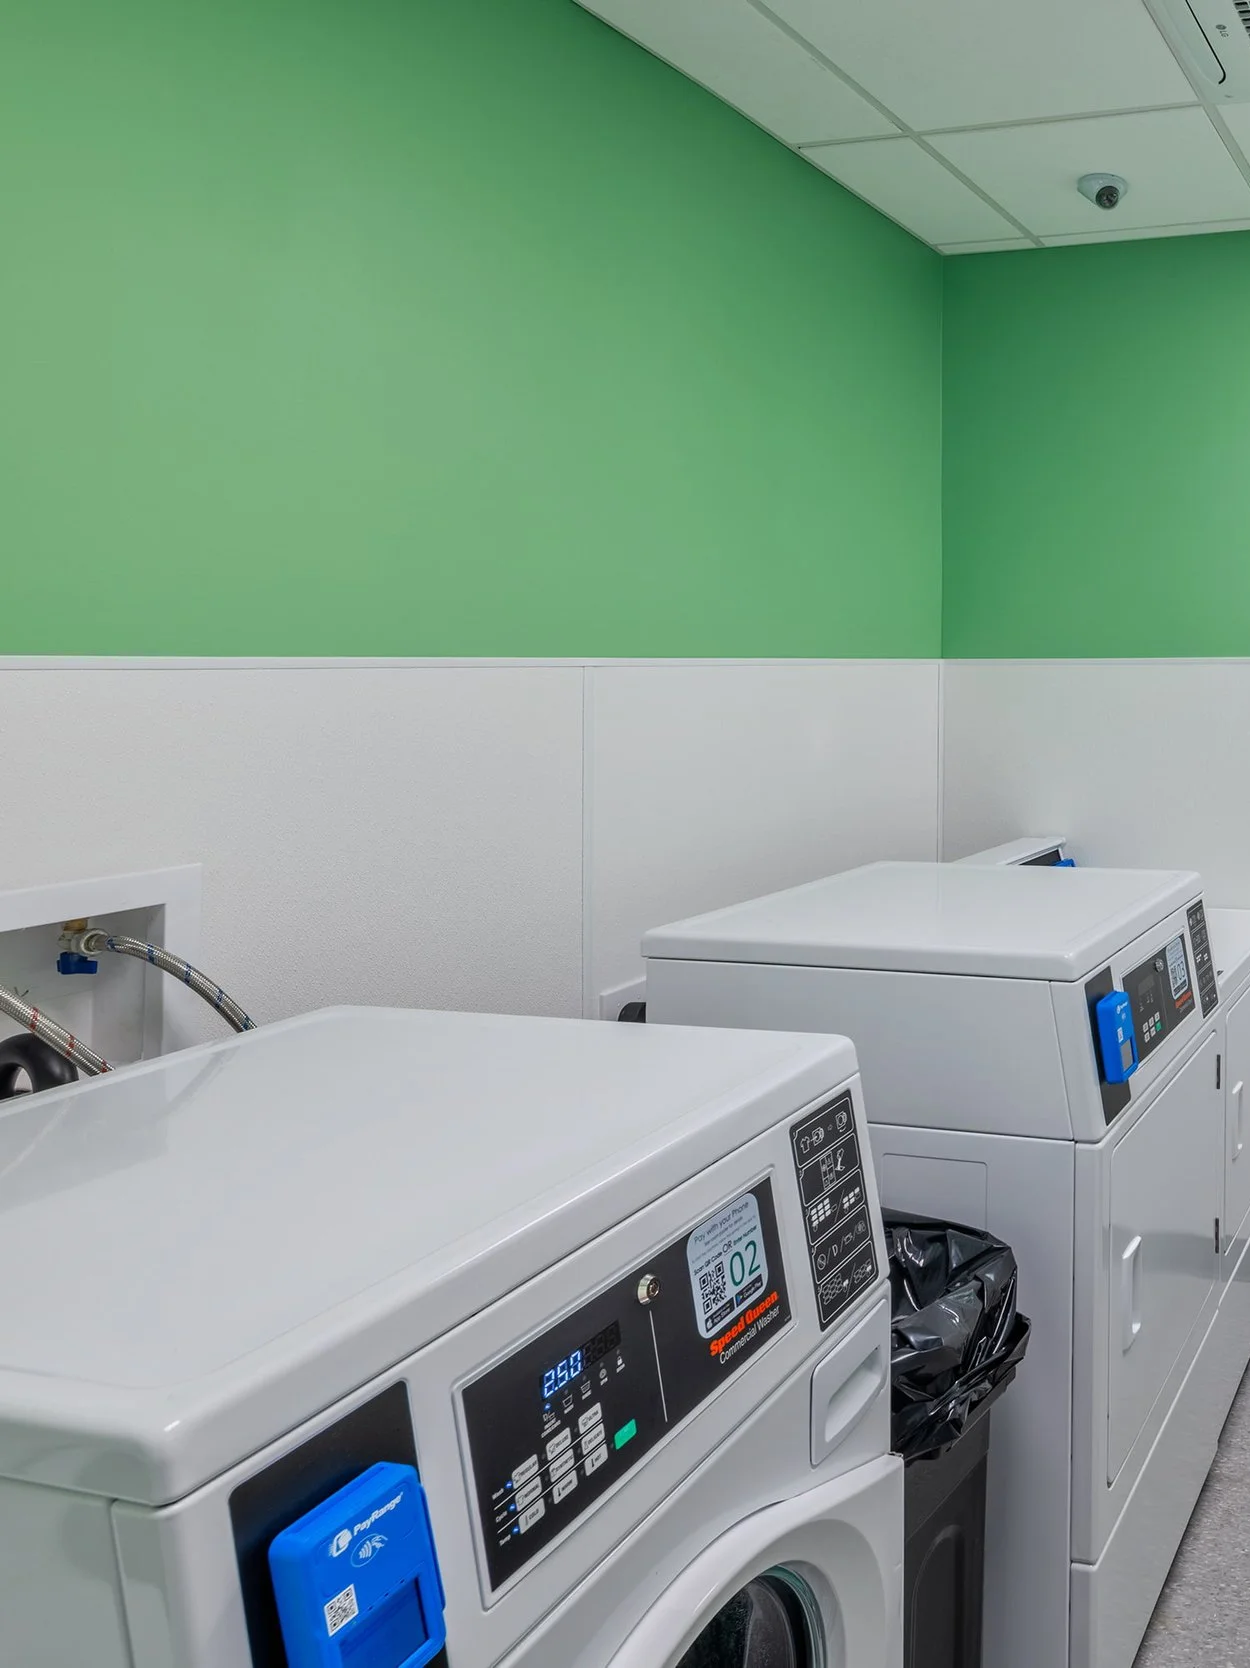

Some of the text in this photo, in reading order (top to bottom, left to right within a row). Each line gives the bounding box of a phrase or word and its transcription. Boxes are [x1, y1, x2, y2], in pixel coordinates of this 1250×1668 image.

[694, 1233, 706, 1246] Pay
[706, 1223, 719, 1236] with
[719, 1214, 732, 1228] your
[732, 1202, 749, 1218] Phone
[742, 1225, 757, 1239] Number
[694, 1252, 722, 1276] Scan QR Code
[722, 1240, 733, 1254] OR
[730, 1240, 761, 1287] 02
[710, 1291, 779, 1357] Speed Queen
[720, 1325, 758, 1364] Commercial
[757, 1305, 780, 1331] Washer
[354, 1492, 401, 1536] PayRange
